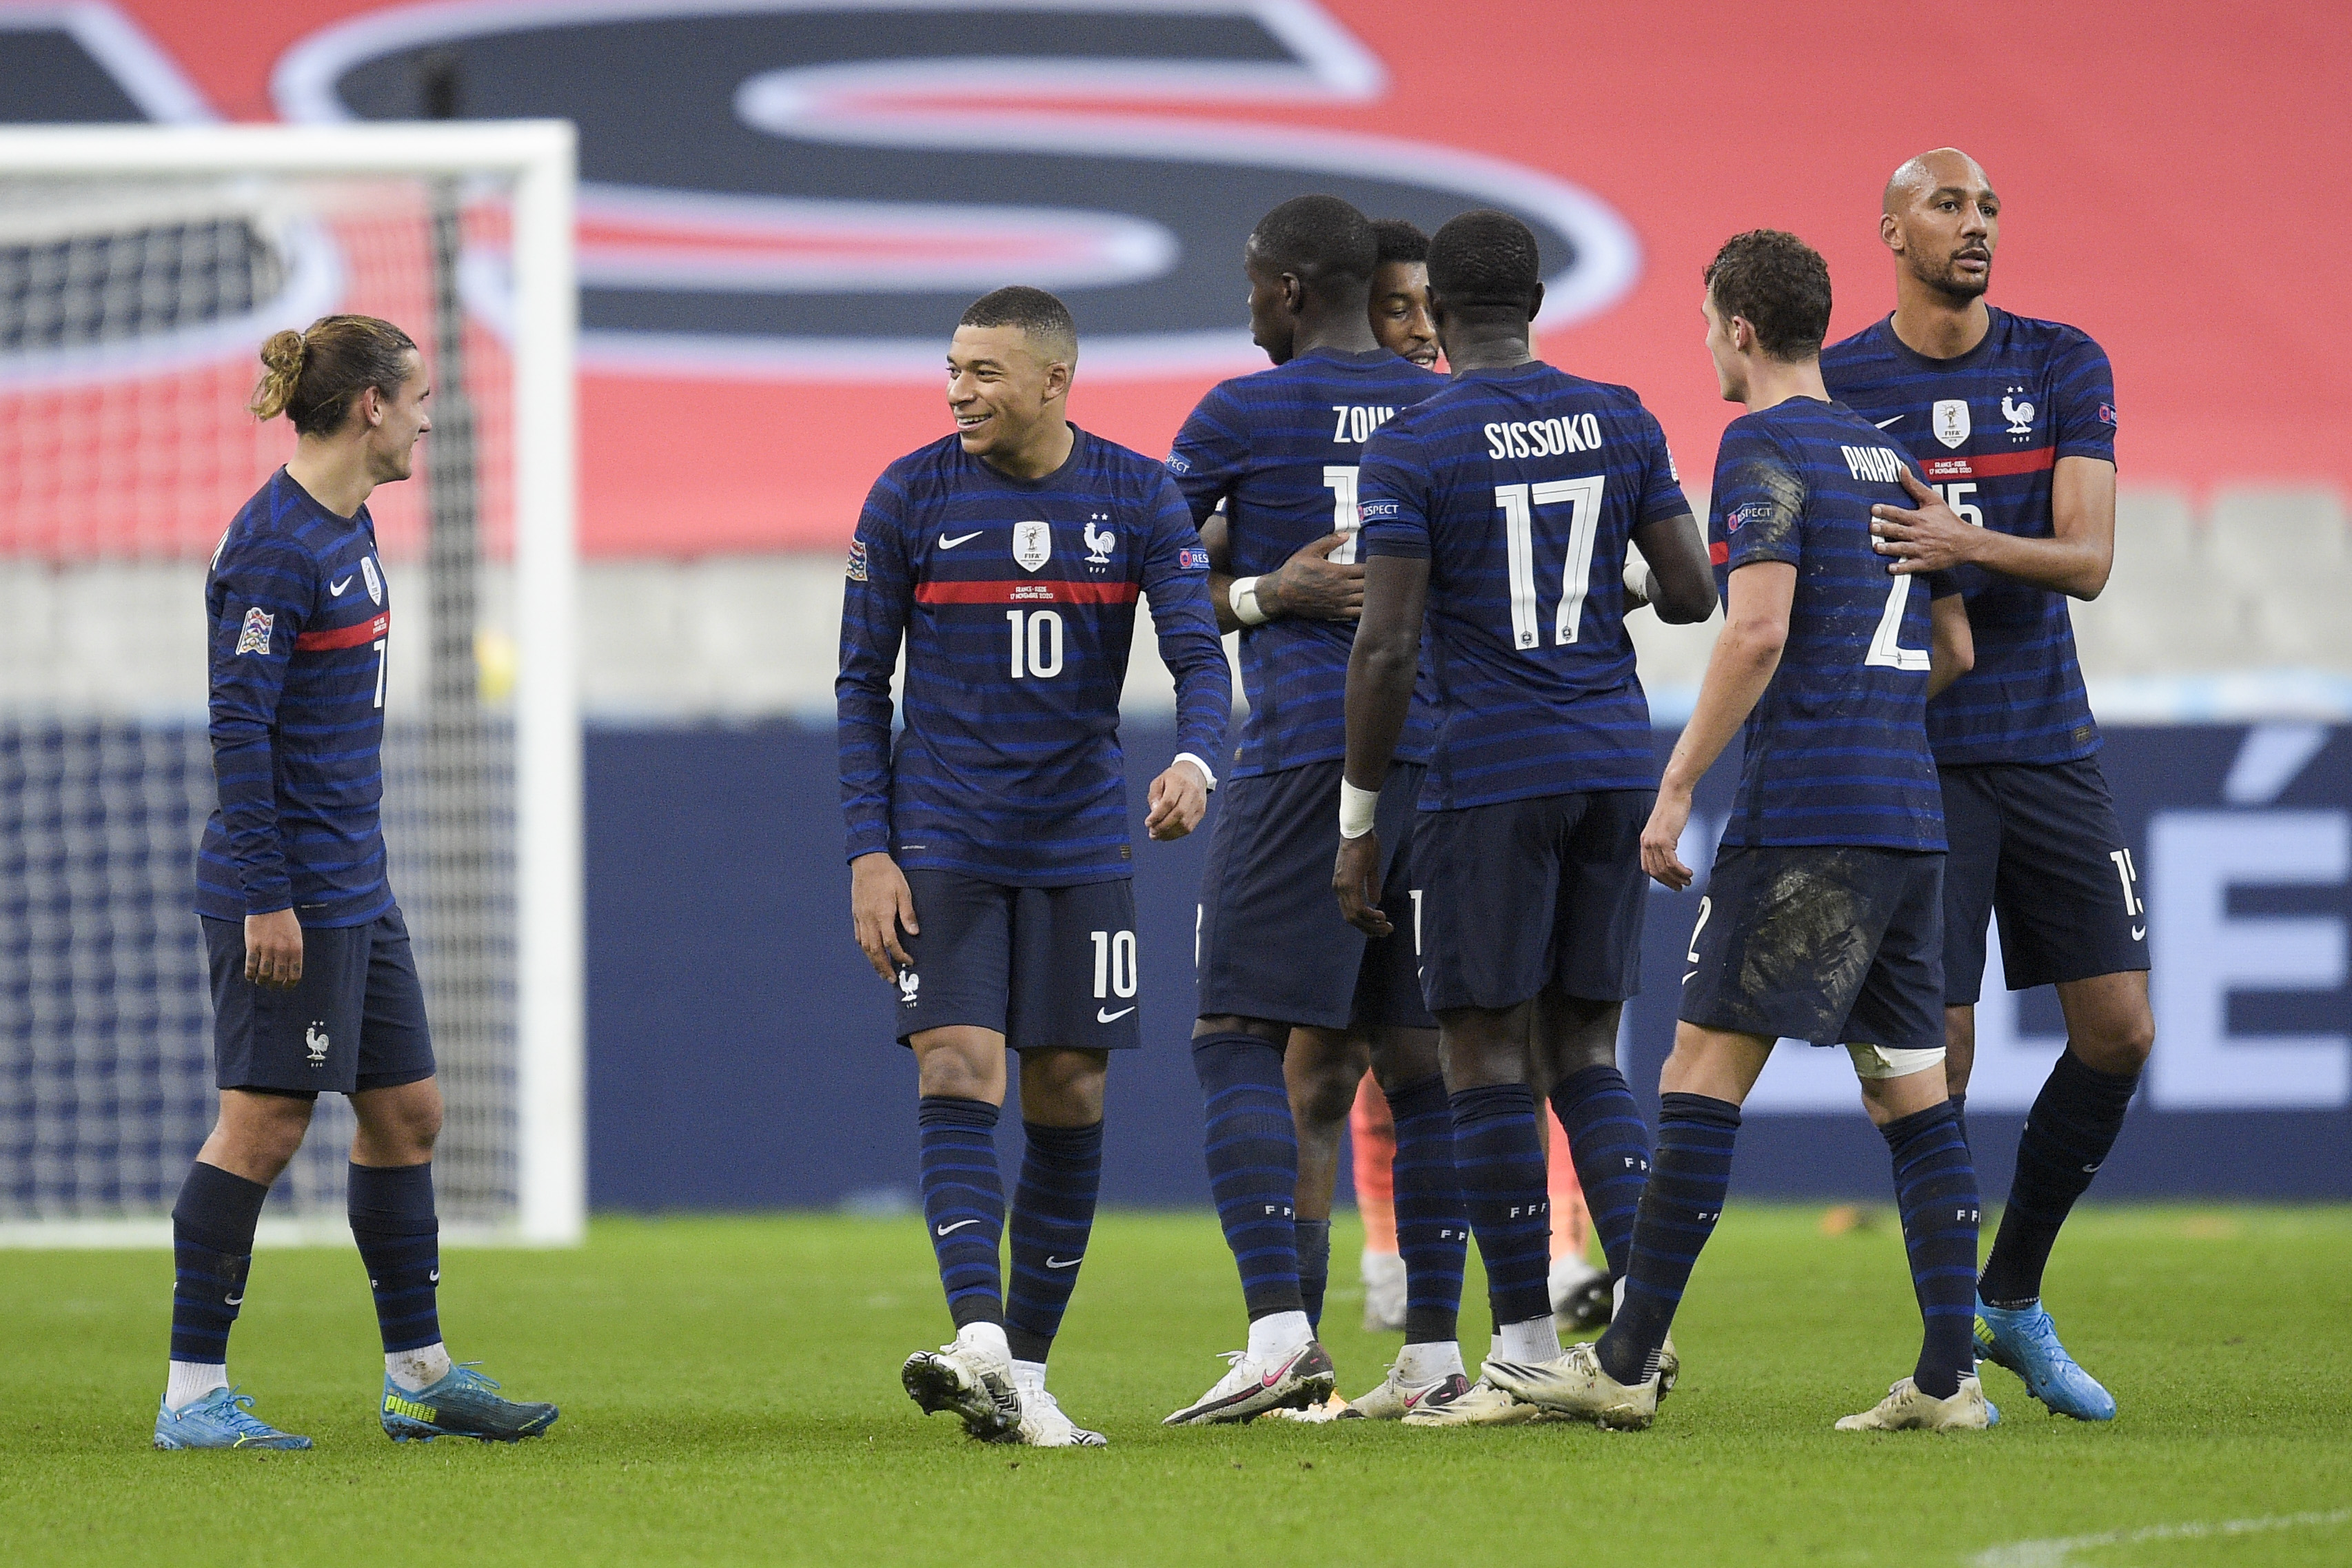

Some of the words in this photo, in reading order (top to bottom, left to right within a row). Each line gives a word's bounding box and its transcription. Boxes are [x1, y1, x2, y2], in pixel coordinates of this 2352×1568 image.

[1332, 406, 1407, 442] ZOU
[1484, 413, 1603, 460] SISSOKO
[1494, 475, 1605, 650] 17
[1006, 609, 1063, 678] 10
[1687, 895, 1711, 964] 2
[1091, 930, 1137, 998] 10
